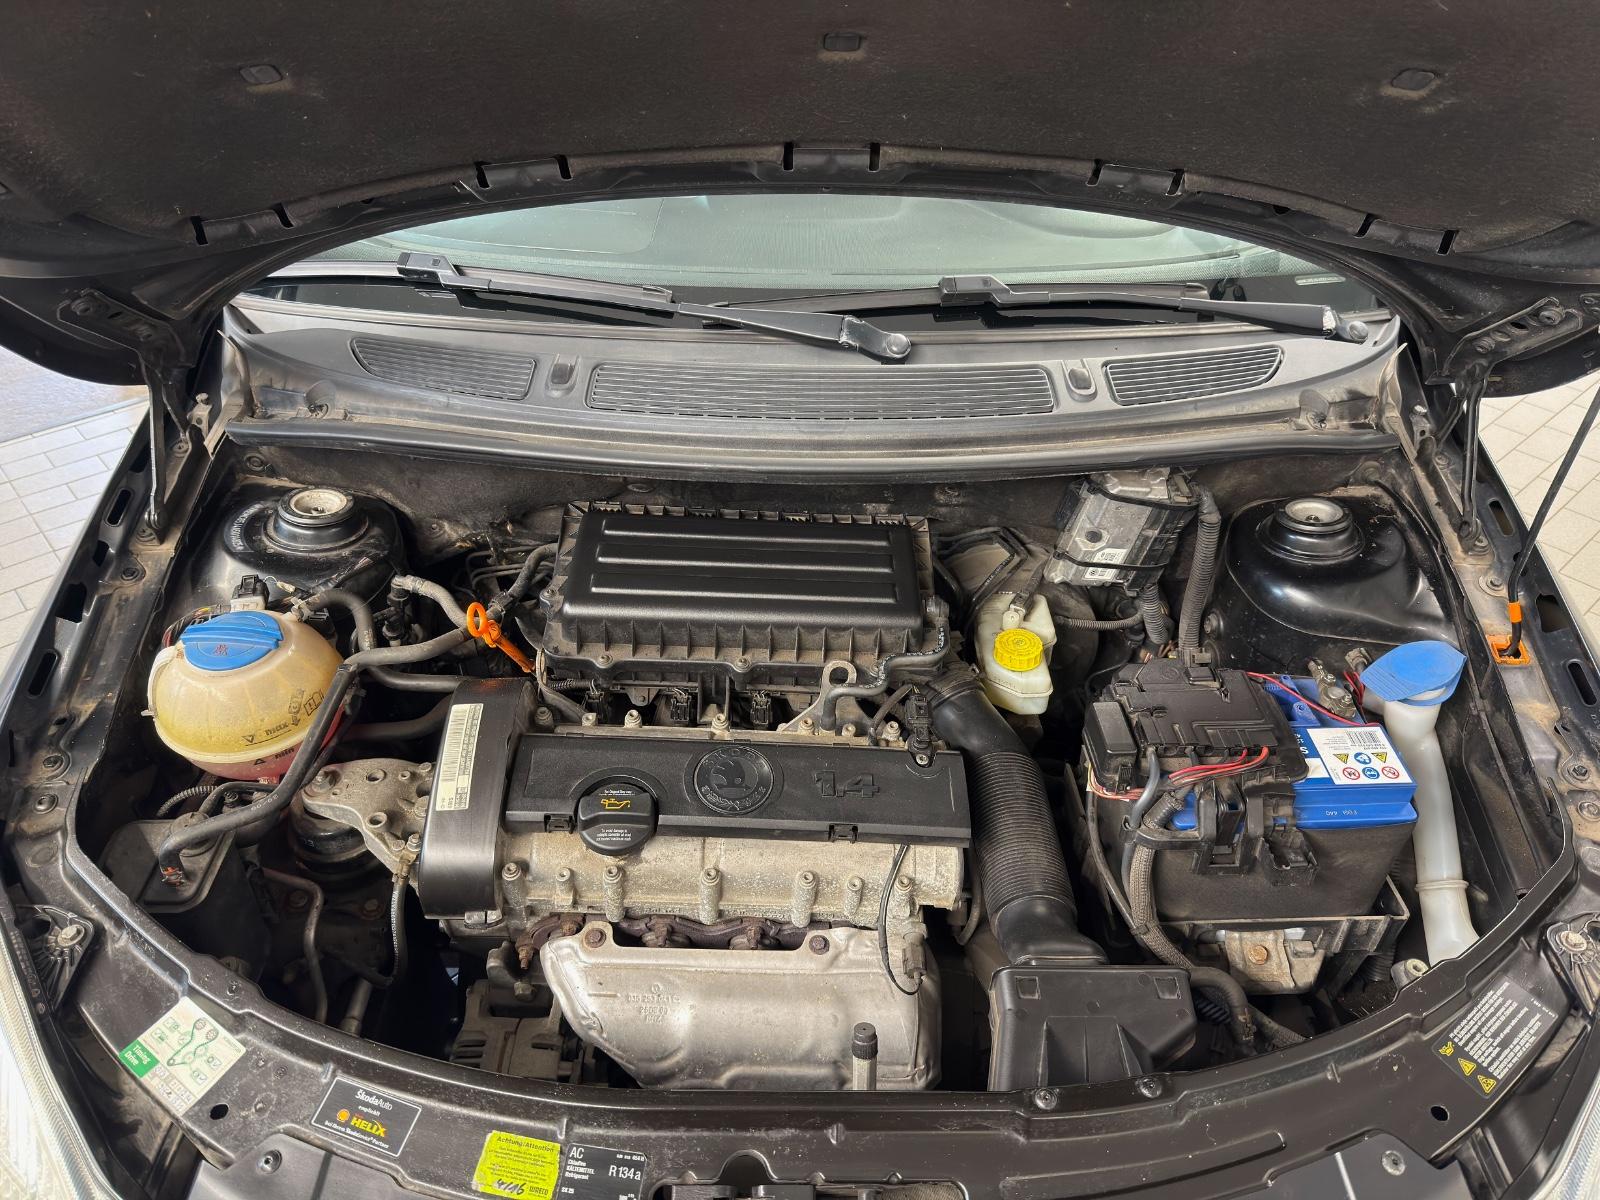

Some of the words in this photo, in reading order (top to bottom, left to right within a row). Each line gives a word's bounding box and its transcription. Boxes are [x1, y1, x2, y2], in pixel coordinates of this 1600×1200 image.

[264, 722, 289, 736] max
[814, 769, 880, 799] 1.4
[124, 1051, 140, 1066] Drive
[132, 1045, 152, 1065] Timing
[355, 1089, 392, 1111] ŠkodaAuto
[350, 1116, 387, 1138] HELIX
[569, 1146, 585, 1159] AC
